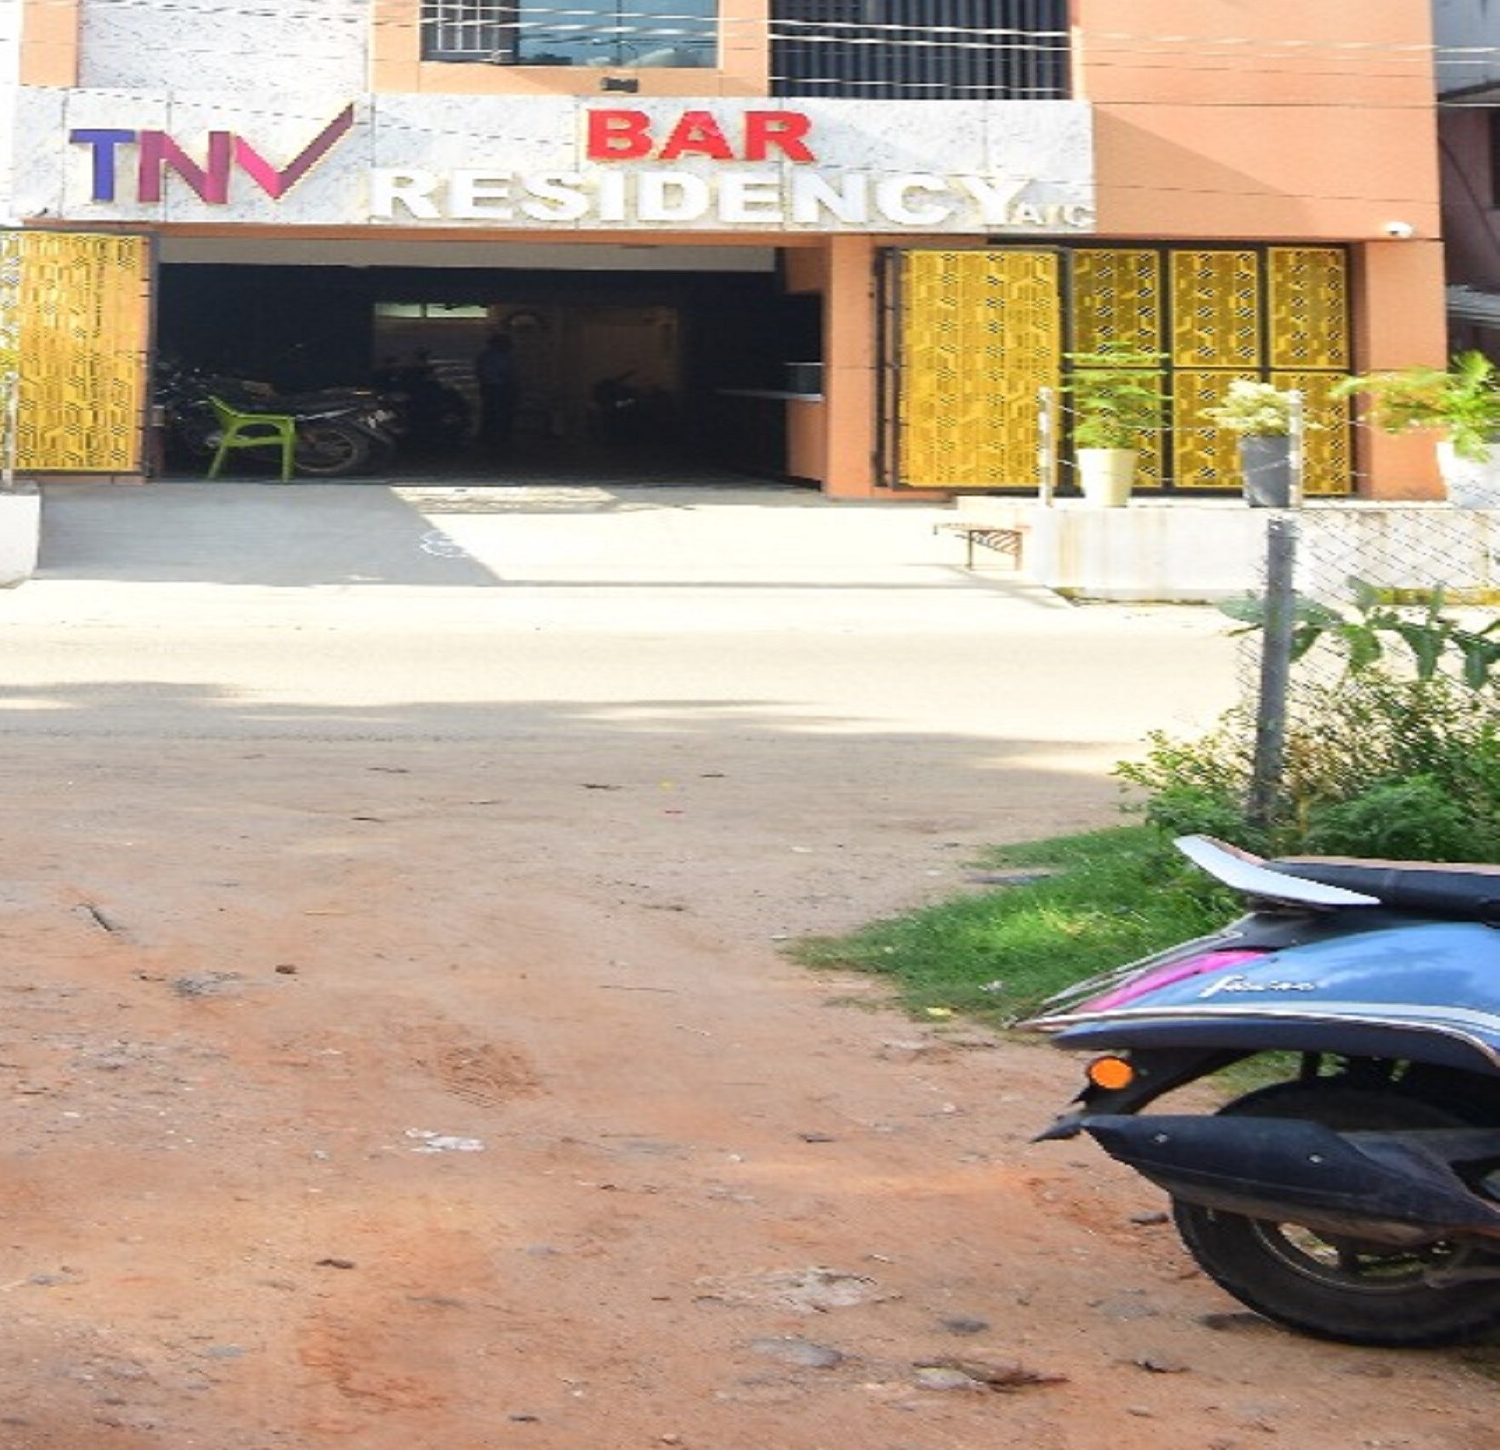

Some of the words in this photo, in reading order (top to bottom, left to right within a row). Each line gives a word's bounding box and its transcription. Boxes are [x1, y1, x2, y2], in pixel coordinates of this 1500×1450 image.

[69, 103, 355, 205] TNV
[586, 108, 816, 163] BAR
[368, 168, 1033, 225] RESIDENCY
